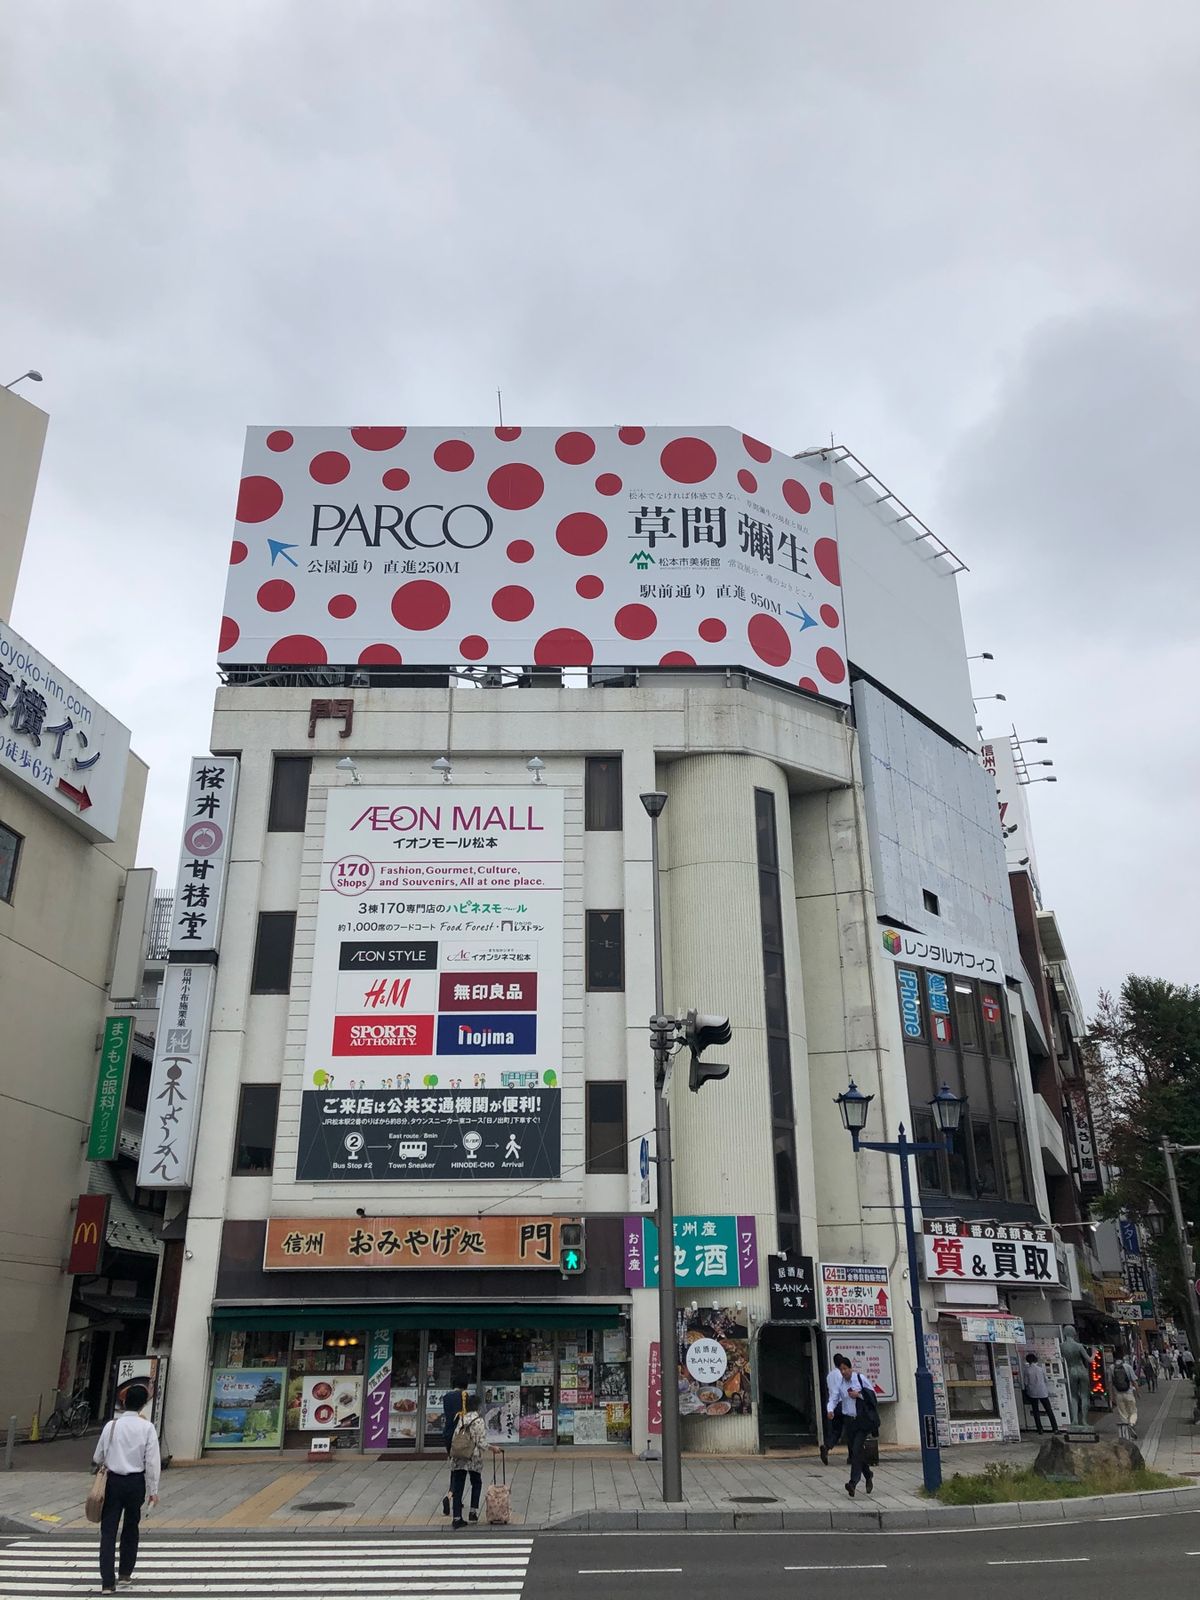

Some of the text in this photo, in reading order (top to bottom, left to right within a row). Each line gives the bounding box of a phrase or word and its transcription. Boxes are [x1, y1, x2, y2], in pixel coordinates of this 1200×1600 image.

[309, 503, 494, 550] PARCO
[307, 559, 373, 574] 公園通り
[658, 557, 721, 567] 松本市美術館
[639, 584, 706, 599] 駅前通り
[0, 633, 92, 725] oyoko-inn.com
[452, 805, 545, 831] MALL
[393, 837, 499, 849] イオンモール松本
[337, 863, 370, 877] 170
[477, 865, 521, 876] Culture,
[337, 878, 367, 889] Shops
[379, 877, 545, 888] and Souvenirs, All at one place.
[178, 859, 215, 941] 甘精堂
[338, 922, 436, 933] 約1,000席のフードコート
[439, 922, 463, 932] Food
[388, 950, 427, 961] STYLE
[471, 953, 532, 962] イオンシネマ松本
[904, 939, 998, 974] レンタルオフィス
[364, 978, 412, 1009] H&M
[453, 983, 523, 1000] 無印良品
[898, 969, 921, 1037] iPhone
[350, 1025, 417, 1038] SPORTS
[322, 1096, 541, 1115] ご来店は公共交通機関が便利!
[346, 1162, 363, 1170] Stop
[282, 1222, 554, 1262] 信州 おみやげ処 門
[627, 1232, 642, 1272] お土産
[740, 1232, 754, 1270] ワイン
[932, 1237, 1053, 1281] 質&買取
[825, 1268, 837, 1280] 24
[370, 1391, 386, 1441] ワイン
